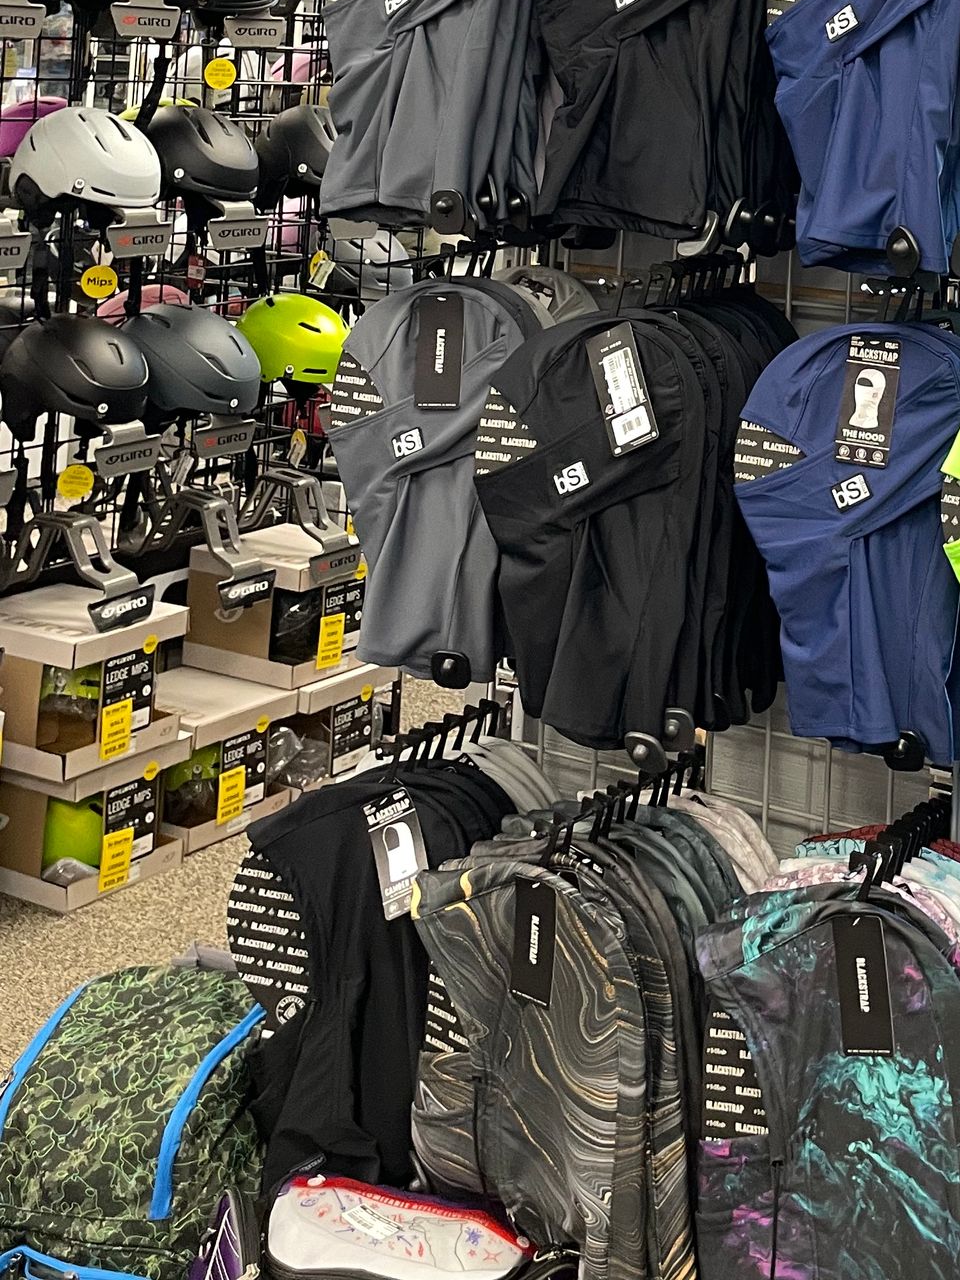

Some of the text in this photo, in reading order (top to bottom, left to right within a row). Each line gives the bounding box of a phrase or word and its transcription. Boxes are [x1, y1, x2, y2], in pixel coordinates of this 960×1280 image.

[137, 15, 171, 28] GIRO
[247, 25, 278, 37] GIRO
[131, 233, 164, 247] GIRO
[231, 226, 262, 239] GIRO
[86, 275, 114, 289] Mips
[435, 328, 446, 374] BLACKSTRAP
[849, 346, 898, 362] BLACKSTRAP
[335, 374, 367, 387] BLACKSTRAP
[331, 403, 361, 416] BLACKSTRAP
[480, 417, 516, 430] BLACKSTRAP
[216, 431, 247, 445] GIRO
[501, 436, 537, 449] BLACKSTRAP
[842, 428, 885, 443] THE HOOD
[119, 447, 154, 462] GIRO
[475, 450, 512, 462] BLACKSTRAP
[734, 453, 774, 468] BLACKSTRAP
[330, 554, 357, 569] GIRO
[240, 581, 269, 596] GIRO
[326, 589, 361, 608] LEDGE MIPS
[116, 596, 147, 617] GIRO
[105, 661, 149, 685] LEDGE MIPS
[334, 704, 369, 726] LEDGE MIPS
[224, 740, 263, 763] LEDGE MIPS
[108, 788, 152, 815] LEDGE MIPS
[366, 797, 411, 826] BLACKSTRAP
[251, 922, 289, 936] BLACKSTRAP
[237, 937, 275, 951] BLACKSTRAP
[530, 915, 539, 965] BLACKSTRAP
[266, 960, 304, 975] BLACKSTRAP
[855, 957, 870, 1013] BLACKSTRAP
[428, 1003, 457, 1024] BLACKSTRAP
[706, 1064, 745, 1078] BLACKSTRAP
[706, 1100, 745, 1114] BLACKSTRAP
